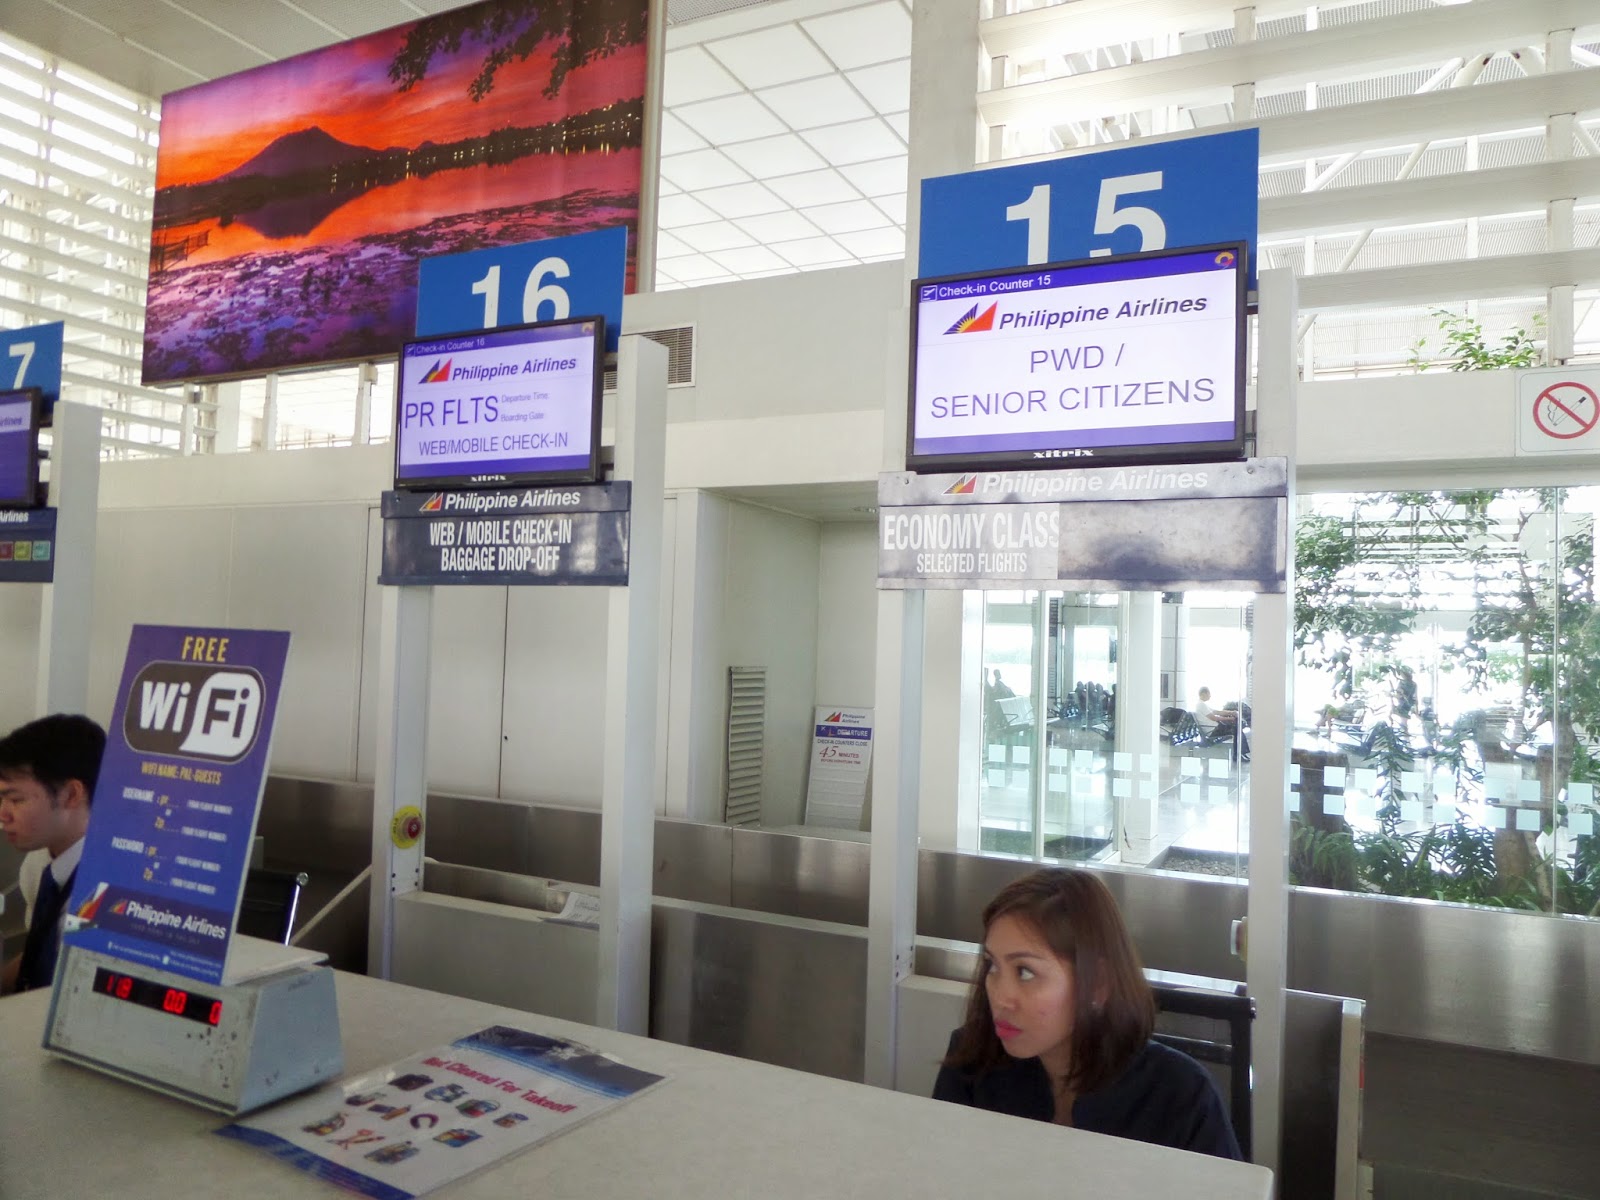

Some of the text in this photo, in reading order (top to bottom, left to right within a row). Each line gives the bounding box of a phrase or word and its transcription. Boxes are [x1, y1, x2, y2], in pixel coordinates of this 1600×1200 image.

[1006, 171, 1166, 265] 15
[472, 257, 570, 329] 16
[939, 274, 1051, 299] Check-in Counter 15
[999, 297, 1207, 330] Philippine Airlines
[416, 338, 485, 355] Check-in Counter 16
[1029, 345, 1104, 373] PWD
[452, 357, 577, 382] Philippine Airlines
[501, 393, 531, 404] Departure
[931, 378, 1215, 419] SENIOR CITIZENS
[404, 395, 498, 429] PR FLTS
[500, 413, 527, 424] Boarding
[419, 432, 568, 456] WEB/MOBILE CHECK-IN
[1033, 448, 1094, 459] xitrix
[982, 469, 1208, 497] Philippine Airlines
[445, 489, 581, 512] Philippine Airlines
[430, 521, 454, 546] WEB
[466, 519, 510, 546] MOBILE
[513, 518, 572, 544] CHECK-IN
[884, 512, 984, 551] ECONOMY
[441, 546, 560, 571] BAGGAGE DROP-OFF
[916, 551, 1027, 574] SELECTED FLIGHTS
[181, 636, 229, 662] FREE
[837, 729, 868, 737] DARTURE
[819, 745, 839, 758] 45
[126, 900, 181, 928] Philippine
[182, 914, 227, 940] Airlines
[446, 1062, 500, 1084] Cleared
[495, 1080, 522, 1093] For
[521, 1089, 578, 1113] Takeoff
